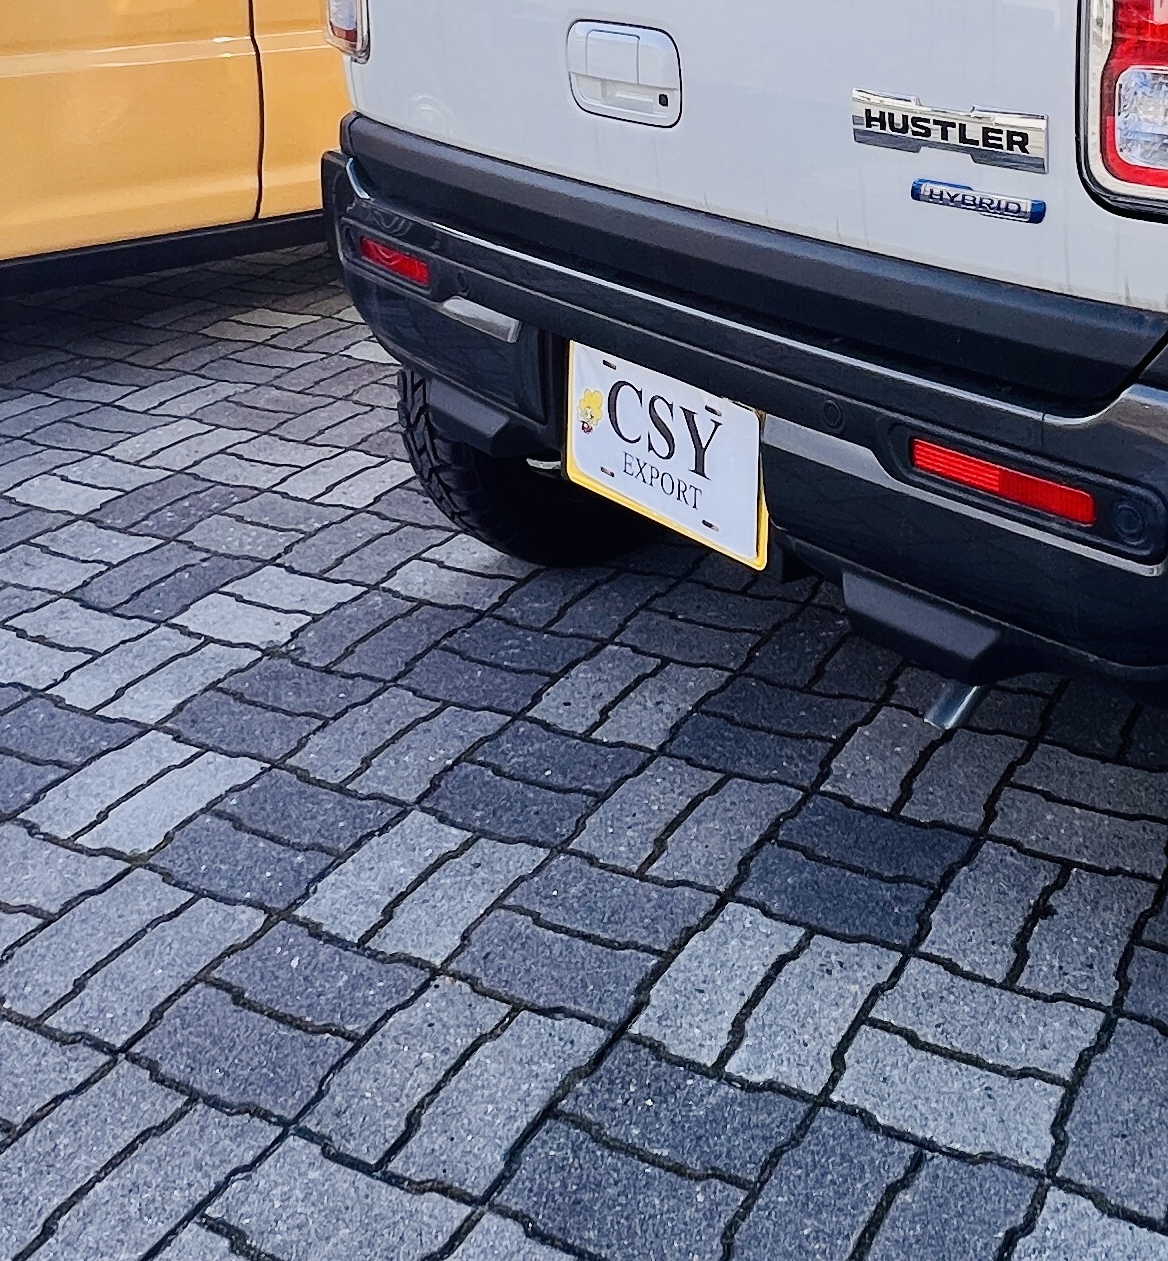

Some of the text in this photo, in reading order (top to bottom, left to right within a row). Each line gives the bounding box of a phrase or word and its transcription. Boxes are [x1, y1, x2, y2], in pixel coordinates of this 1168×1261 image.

[864, 108, 1030, 155] HUSTLER
[928, 188, 1022, 215] HYBRID
[607, 380, 724, 482] CSY
[623, 450, 703, 511] EXPORT
